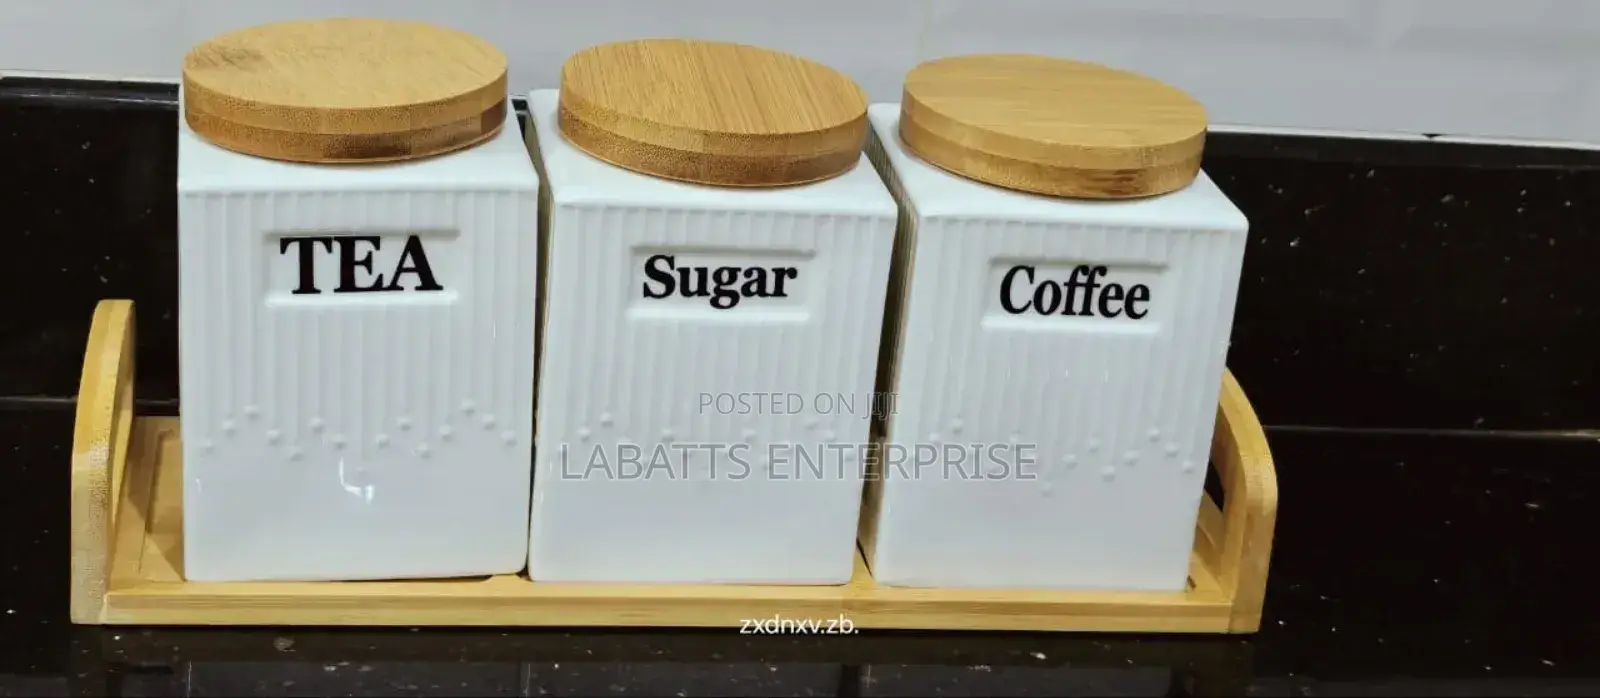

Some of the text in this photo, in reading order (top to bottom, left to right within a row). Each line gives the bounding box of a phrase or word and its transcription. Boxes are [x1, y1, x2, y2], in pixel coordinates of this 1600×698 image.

[280, 235, 443, 294] TEA
[644, 255, 797, 309] Sugar
[1000, 264, 1149, 319] Coffee
